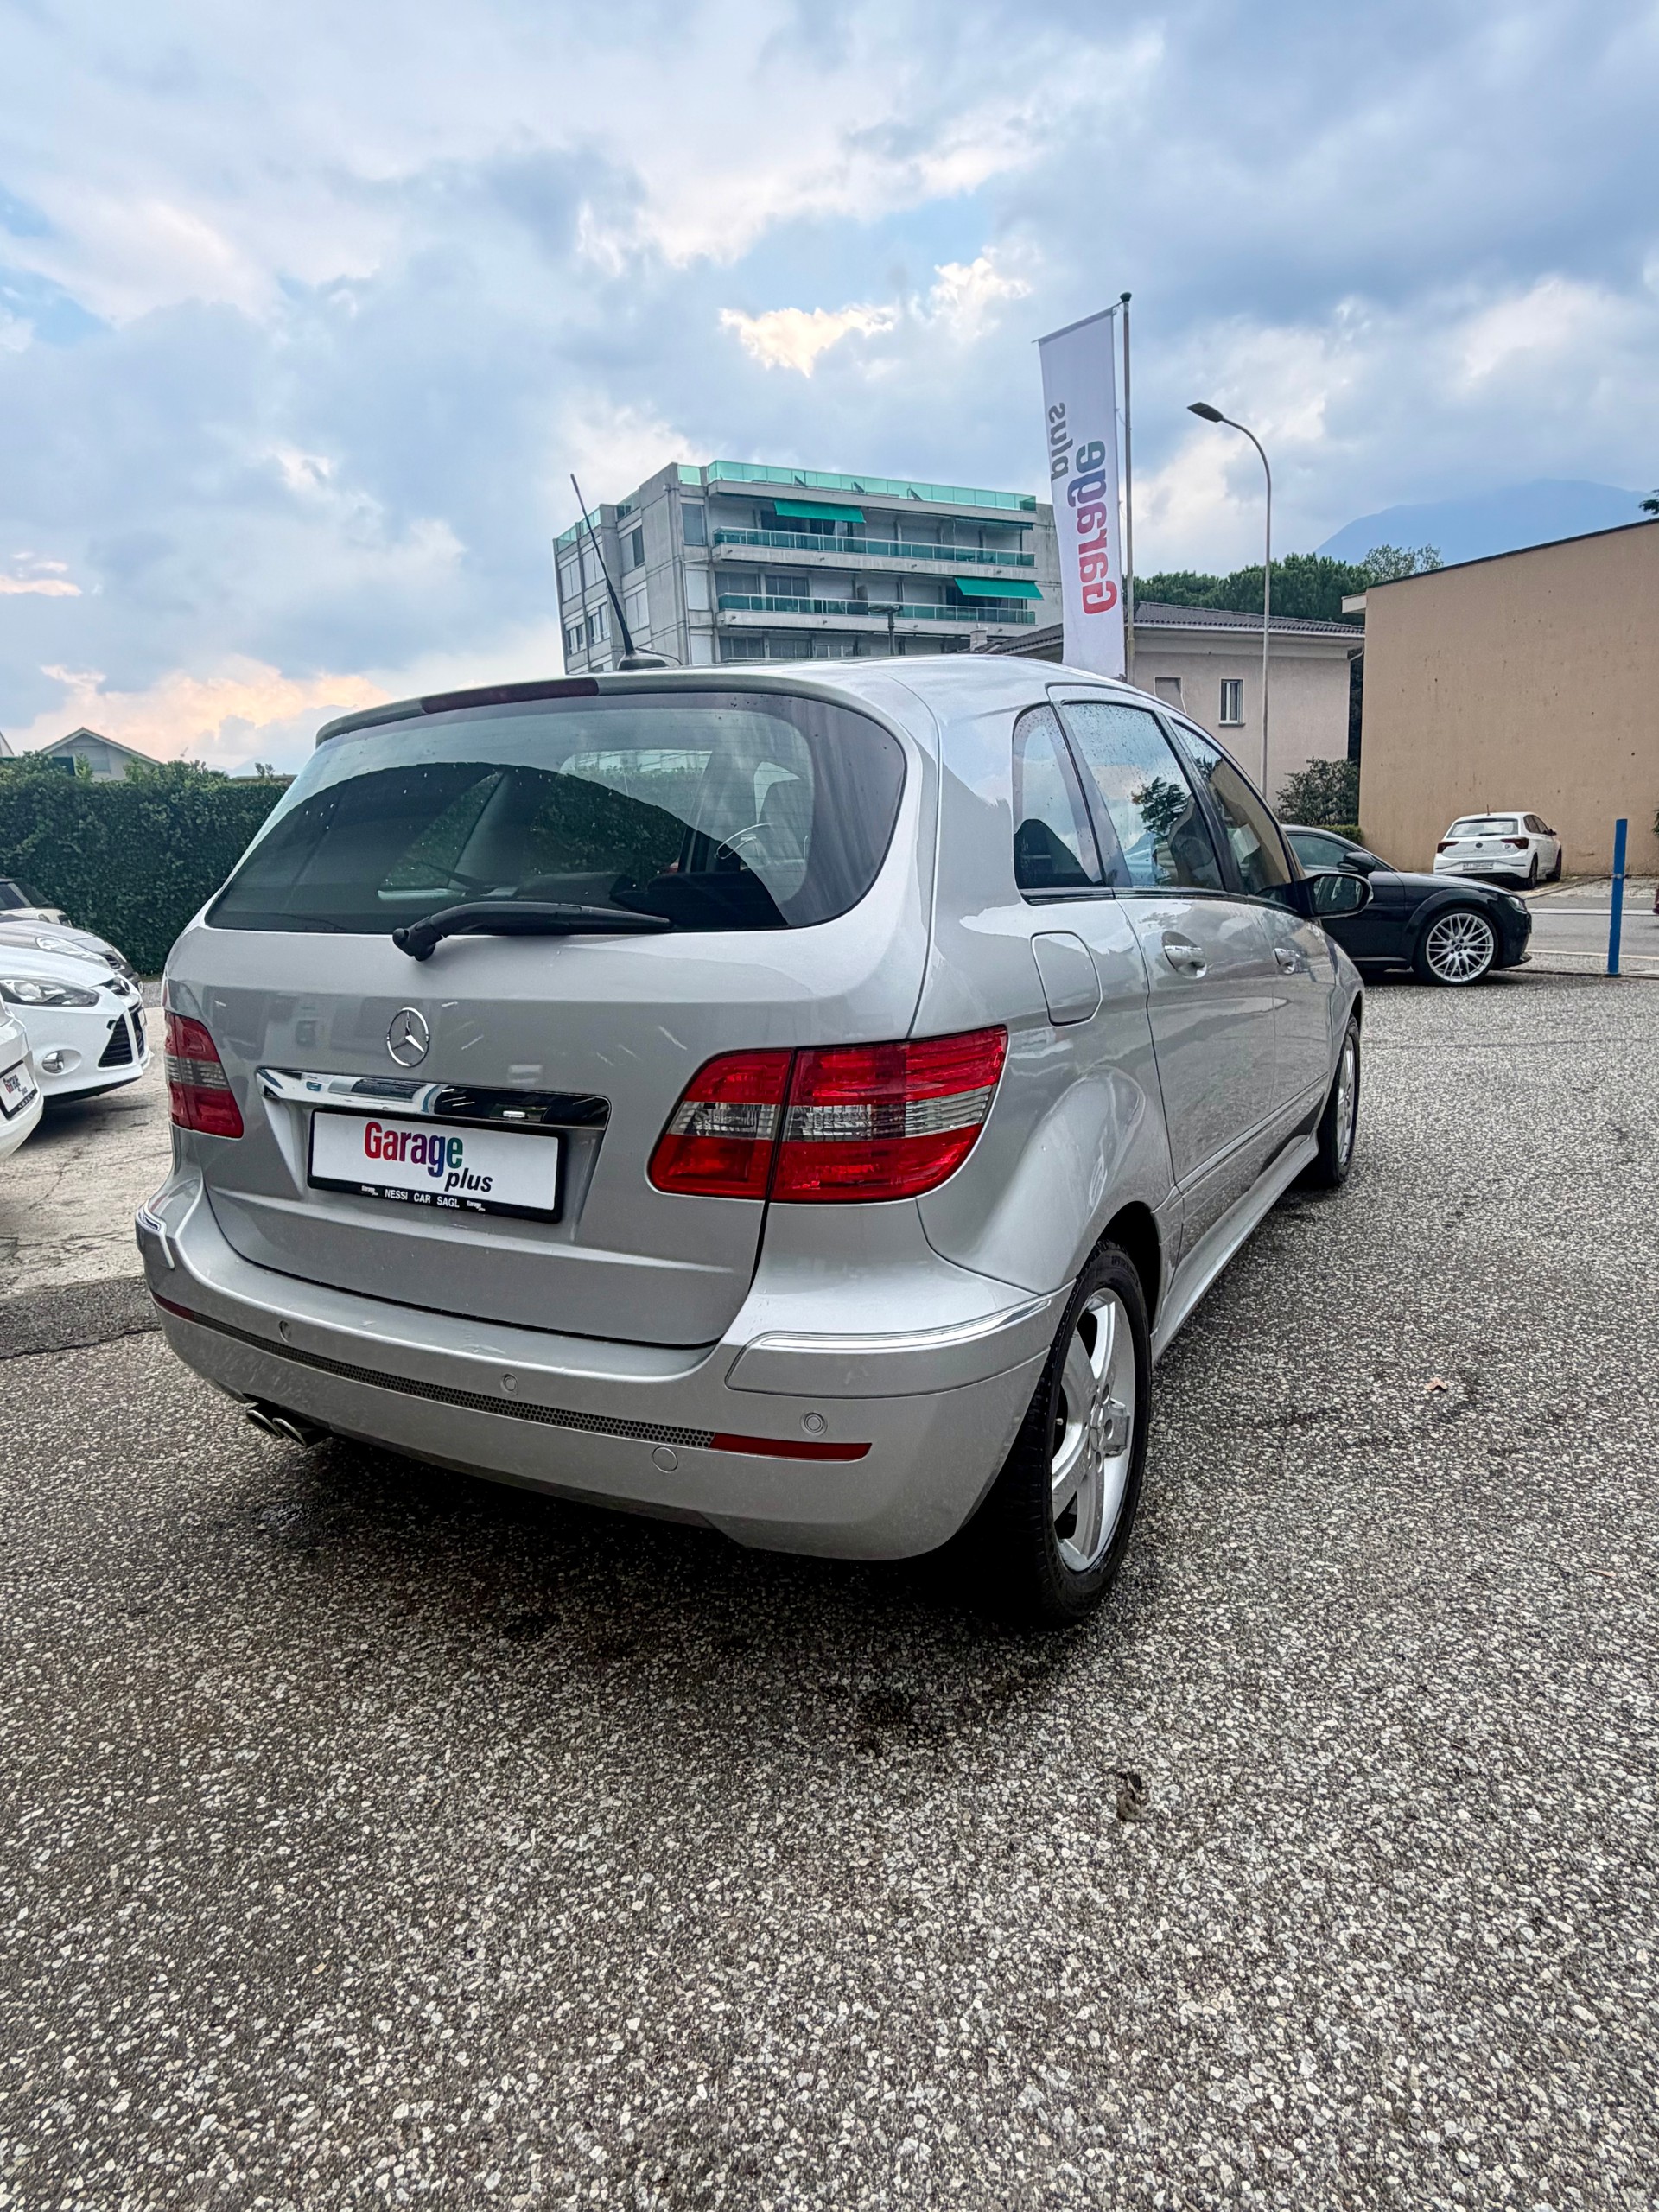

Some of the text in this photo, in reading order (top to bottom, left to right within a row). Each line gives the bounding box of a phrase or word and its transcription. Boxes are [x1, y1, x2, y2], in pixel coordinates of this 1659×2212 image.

[365, 1122, 463, 1177] Garage
[445, 1168, 493, 1192] plus
[385, 1189, 460, 1208] NESSI CAR SAGL
